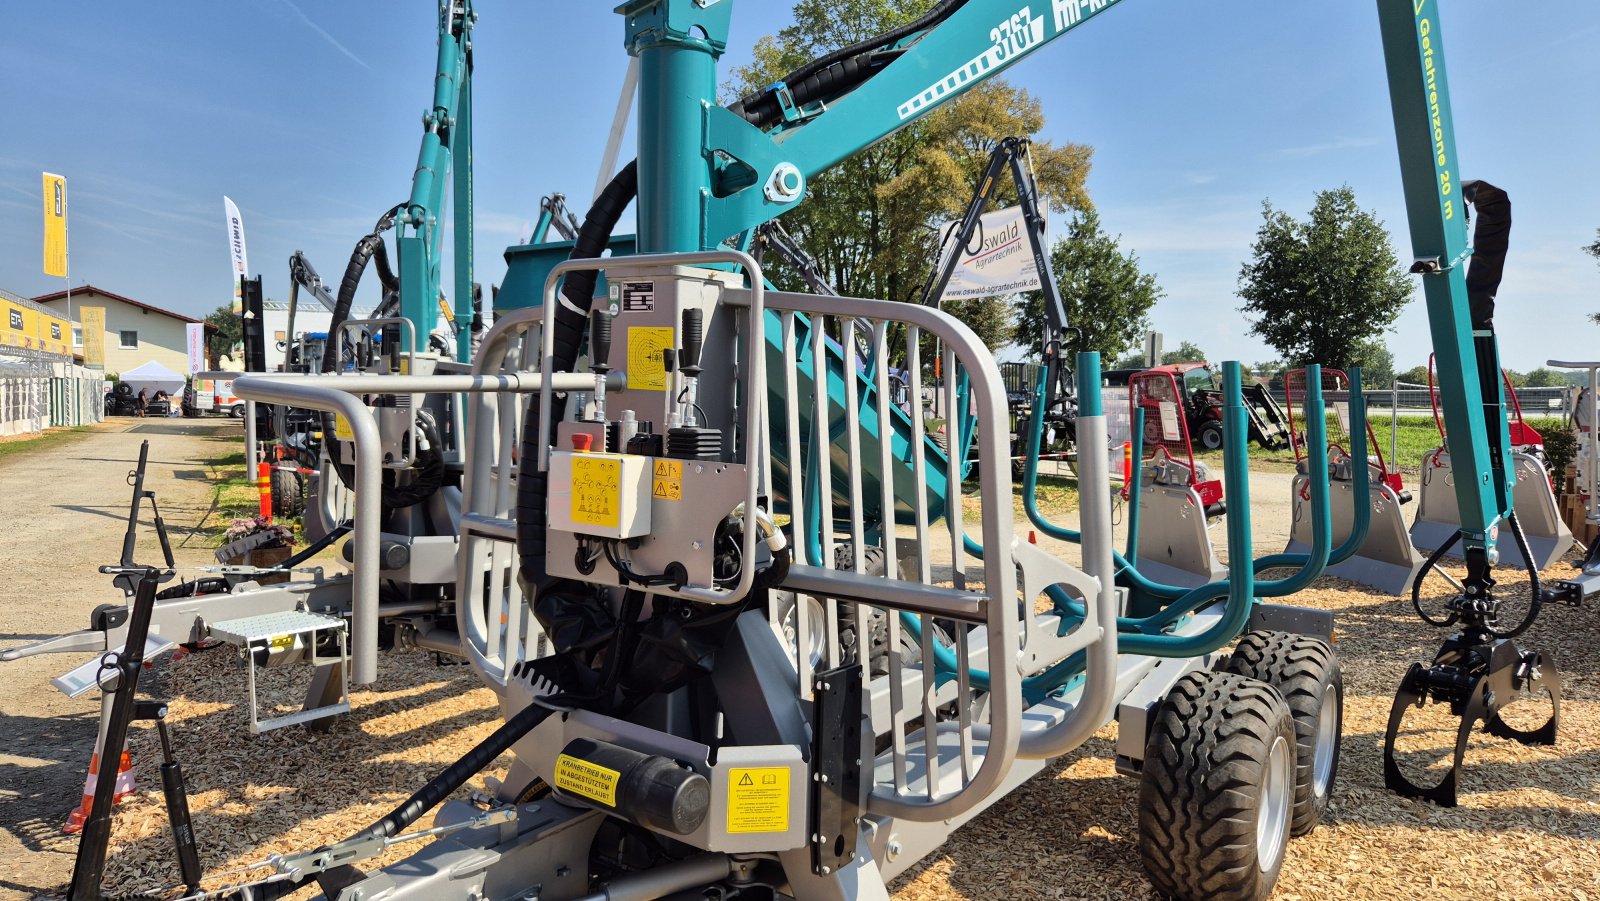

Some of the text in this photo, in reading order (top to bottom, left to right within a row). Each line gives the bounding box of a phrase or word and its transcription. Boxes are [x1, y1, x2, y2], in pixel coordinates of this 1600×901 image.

[989, 5, 1032, 61] 3767
[1420, 18, 1453, 220] Gefahrenzone 20 m
[975, 241, 1023, 270] Agrartechnik
[945, 277, 1038, 297] www.oswald-agrartechnik.de
[560, 769, 567, 777] IN
[561, 760, 613, 783] KRANBETRIEB NUR
[559, 777, 610, 800] ZUSTAND ERLAUBT
